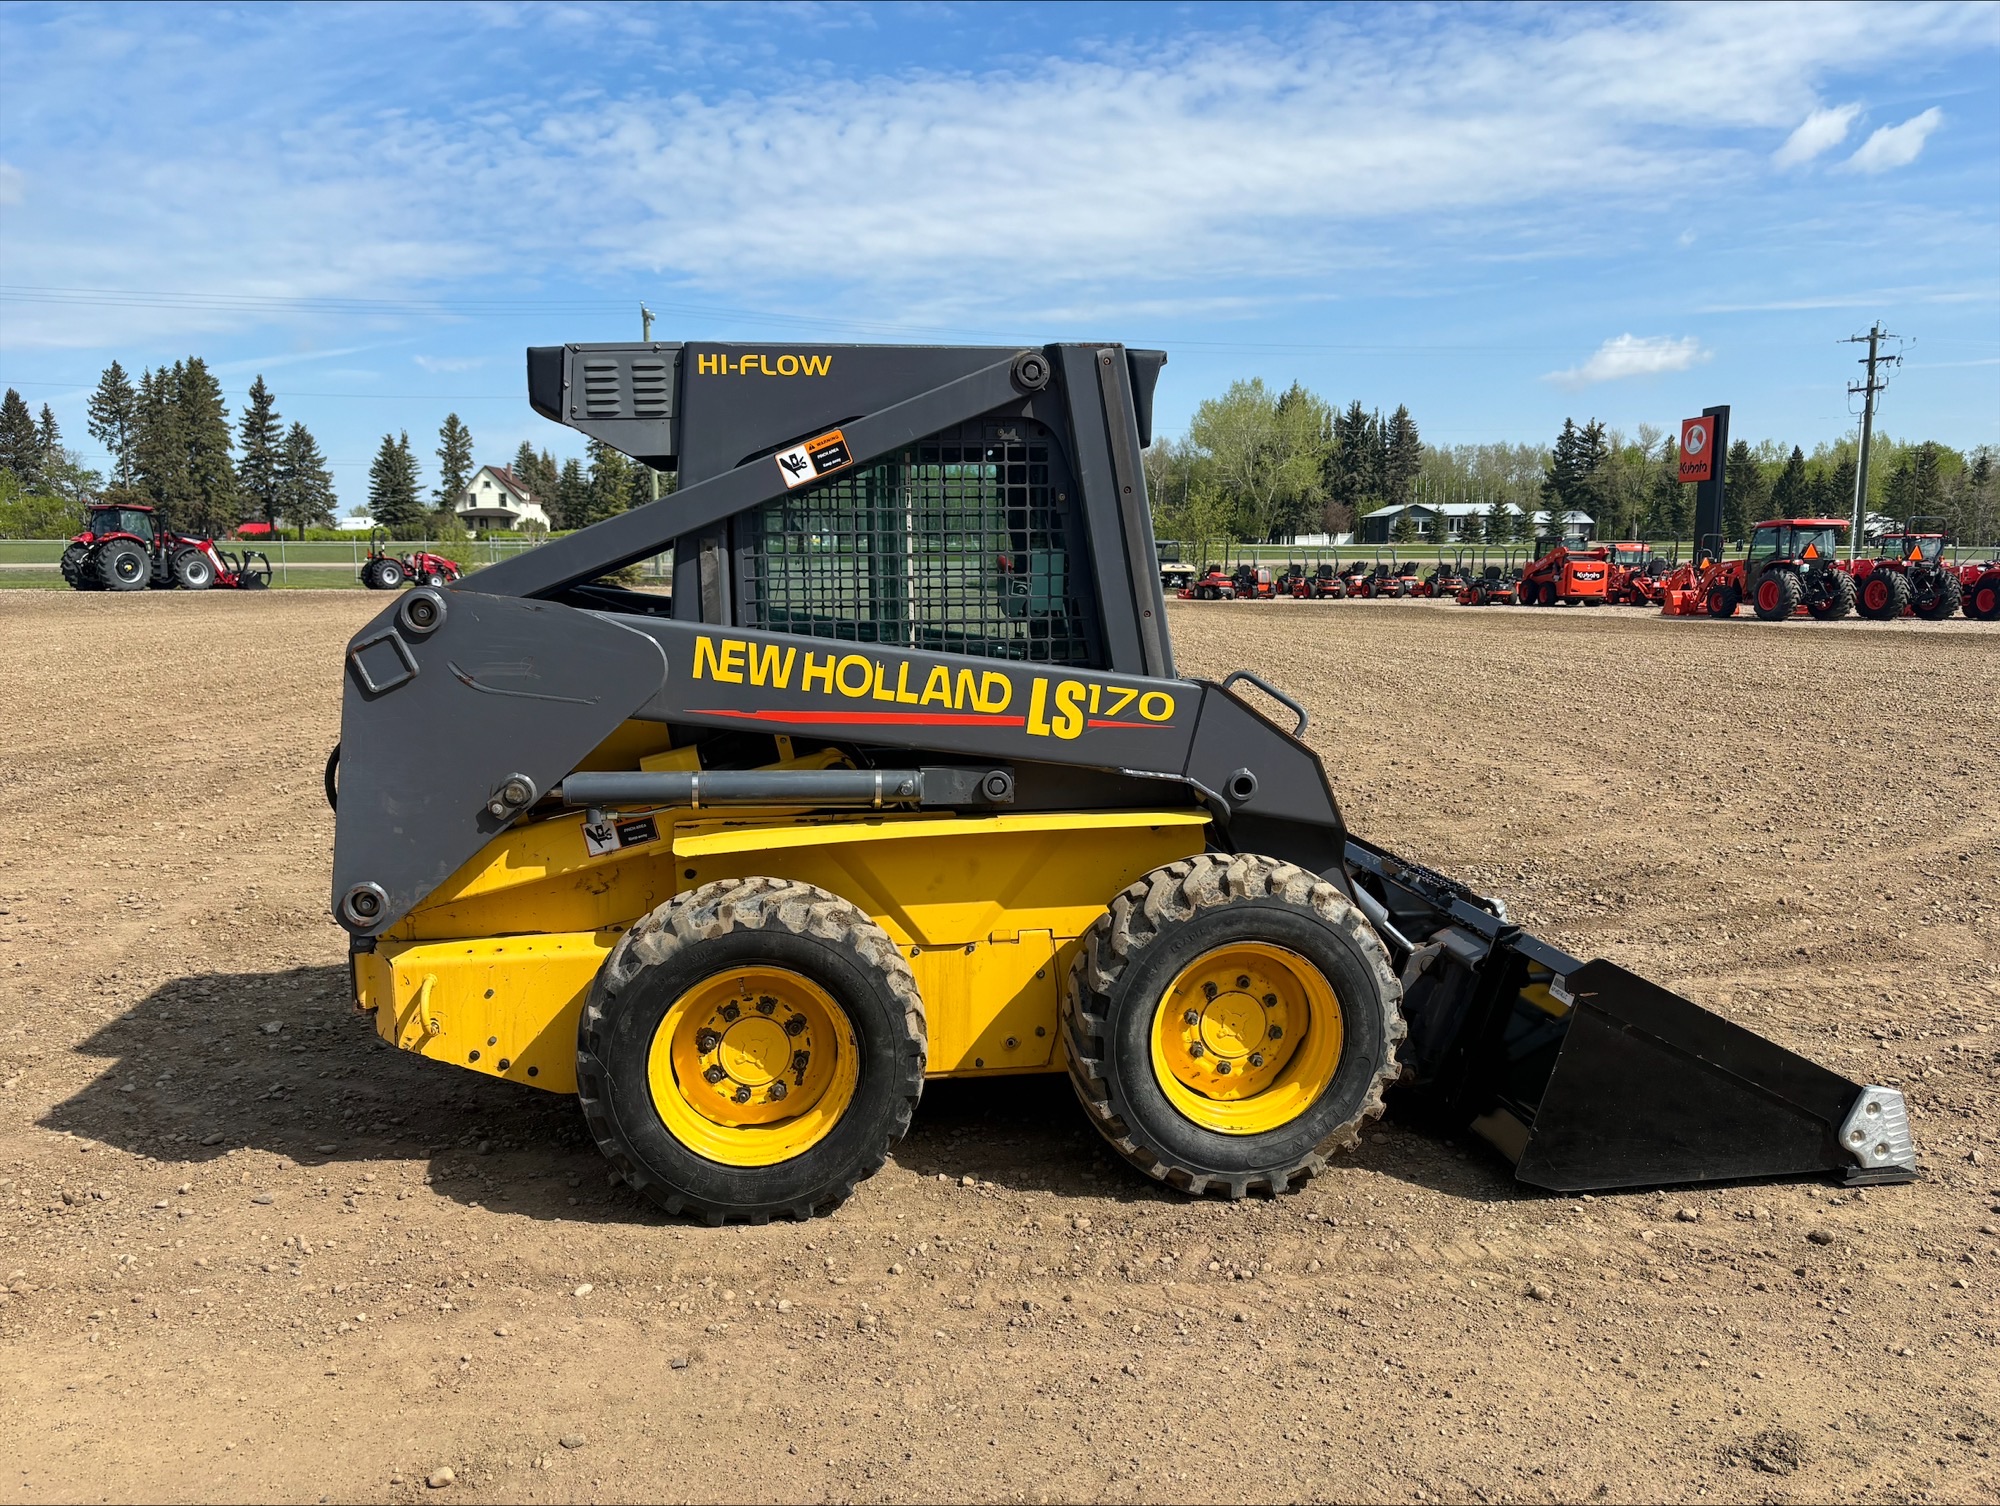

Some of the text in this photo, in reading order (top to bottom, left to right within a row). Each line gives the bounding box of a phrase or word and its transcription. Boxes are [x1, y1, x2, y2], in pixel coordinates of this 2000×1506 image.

[697, 354, 833, 377] HI-FLOW
[816, 435, 840, 447] WARNING
[1679, 460, 1708, 474] Kubota
[1576, 571, 1600, 579] Kubota
[692, 635, 797, 689] NEW
[800, 651, 1014, 715] HOLLAND
